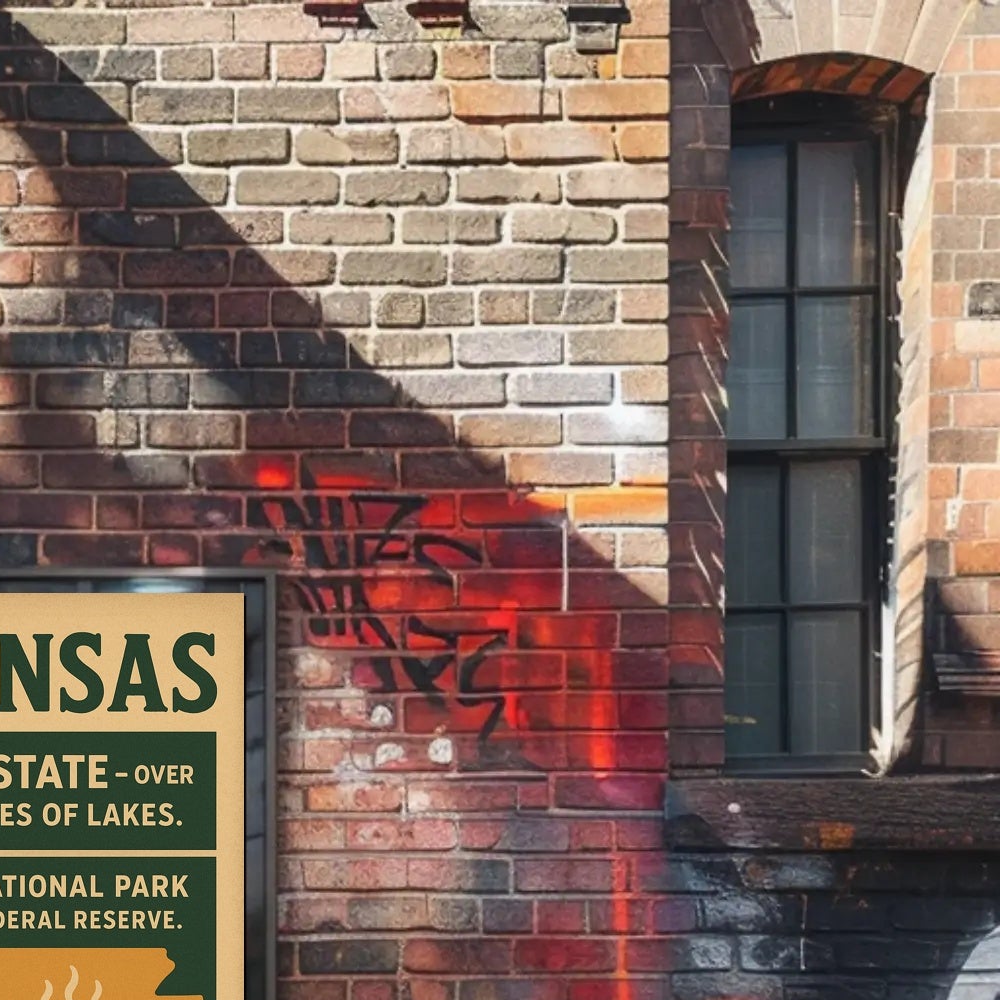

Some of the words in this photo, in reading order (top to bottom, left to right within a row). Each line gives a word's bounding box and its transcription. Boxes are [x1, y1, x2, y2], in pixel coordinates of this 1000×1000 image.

[134, 764, 194, 785] OVER
[42, 802, 79, 827] OF
[87, 802, 183, 827] LAKES.
[115, 874, 189, 898] PARK
[74, 910, 183, 930] RESERVE.
